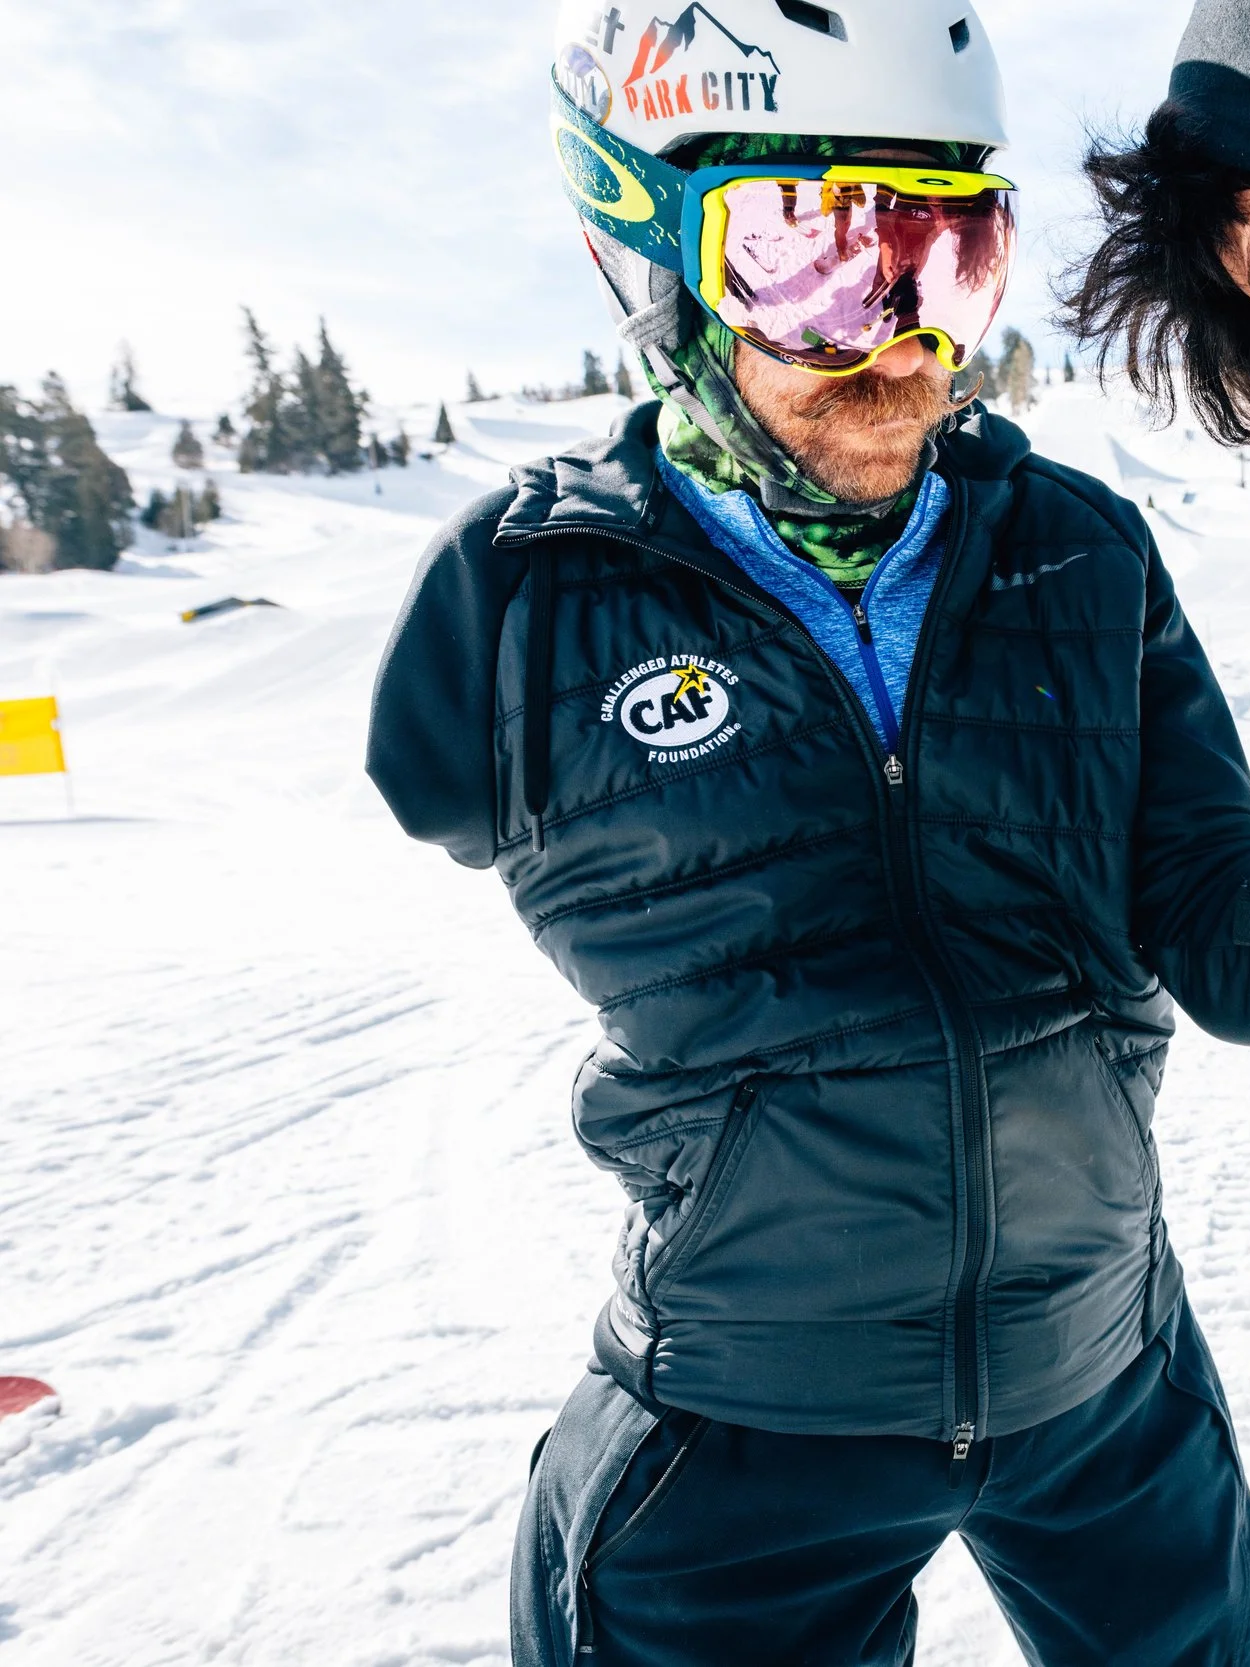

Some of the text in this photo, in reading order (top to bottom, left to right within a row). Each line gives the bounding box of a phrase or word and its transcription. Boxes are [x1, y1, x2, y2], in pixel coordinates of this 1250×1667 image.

[624, 74, 693, 121] PARK
[701, 71, 778, 113] CITY
[600, 654, 739, 722] CHALLENGED ATHLETES
[629, 681, 713, 735] CAF
